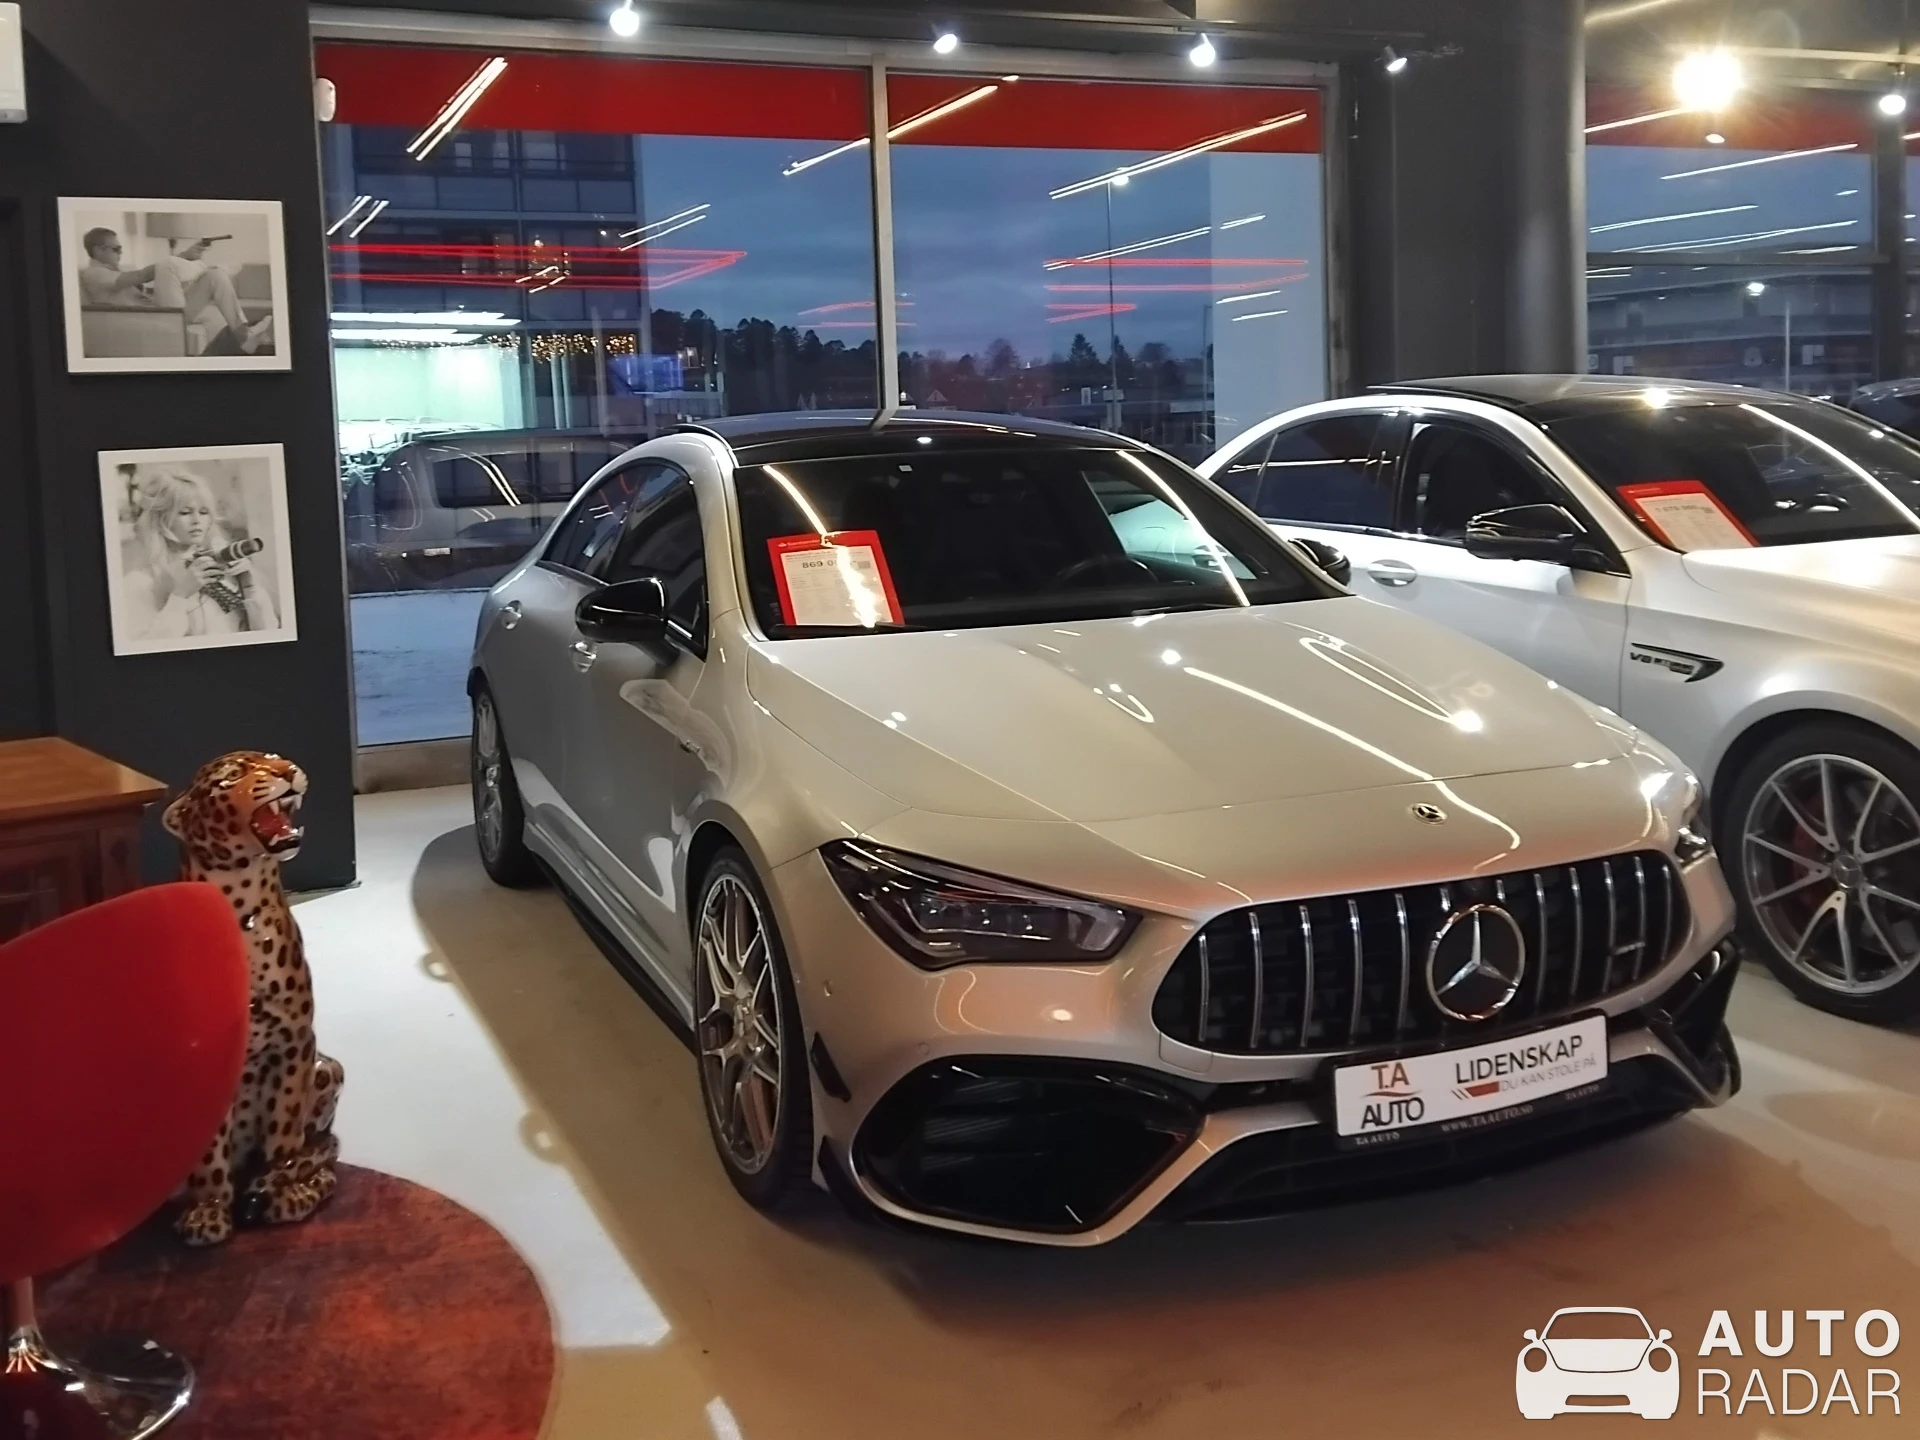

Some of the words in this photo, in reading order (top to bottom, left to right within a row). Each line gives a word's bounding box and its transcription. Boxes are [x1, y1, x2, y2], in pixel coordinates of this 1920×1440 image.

[802, 560, 823, 568] 869
[1456, 1034, 1583, 1084] LIDENSKAP
[1371, 1061, 1410, 1089] T.A
[1502, 1077, 1518, 1092] DU
[1521, 1071, 1546, 1086] KAN
[1548, 1061, 1580, 1080] STOLE
[1361, 1096, 1424, 1129] AUTO
[1370, 1131, 1400, 1144] AUTO
